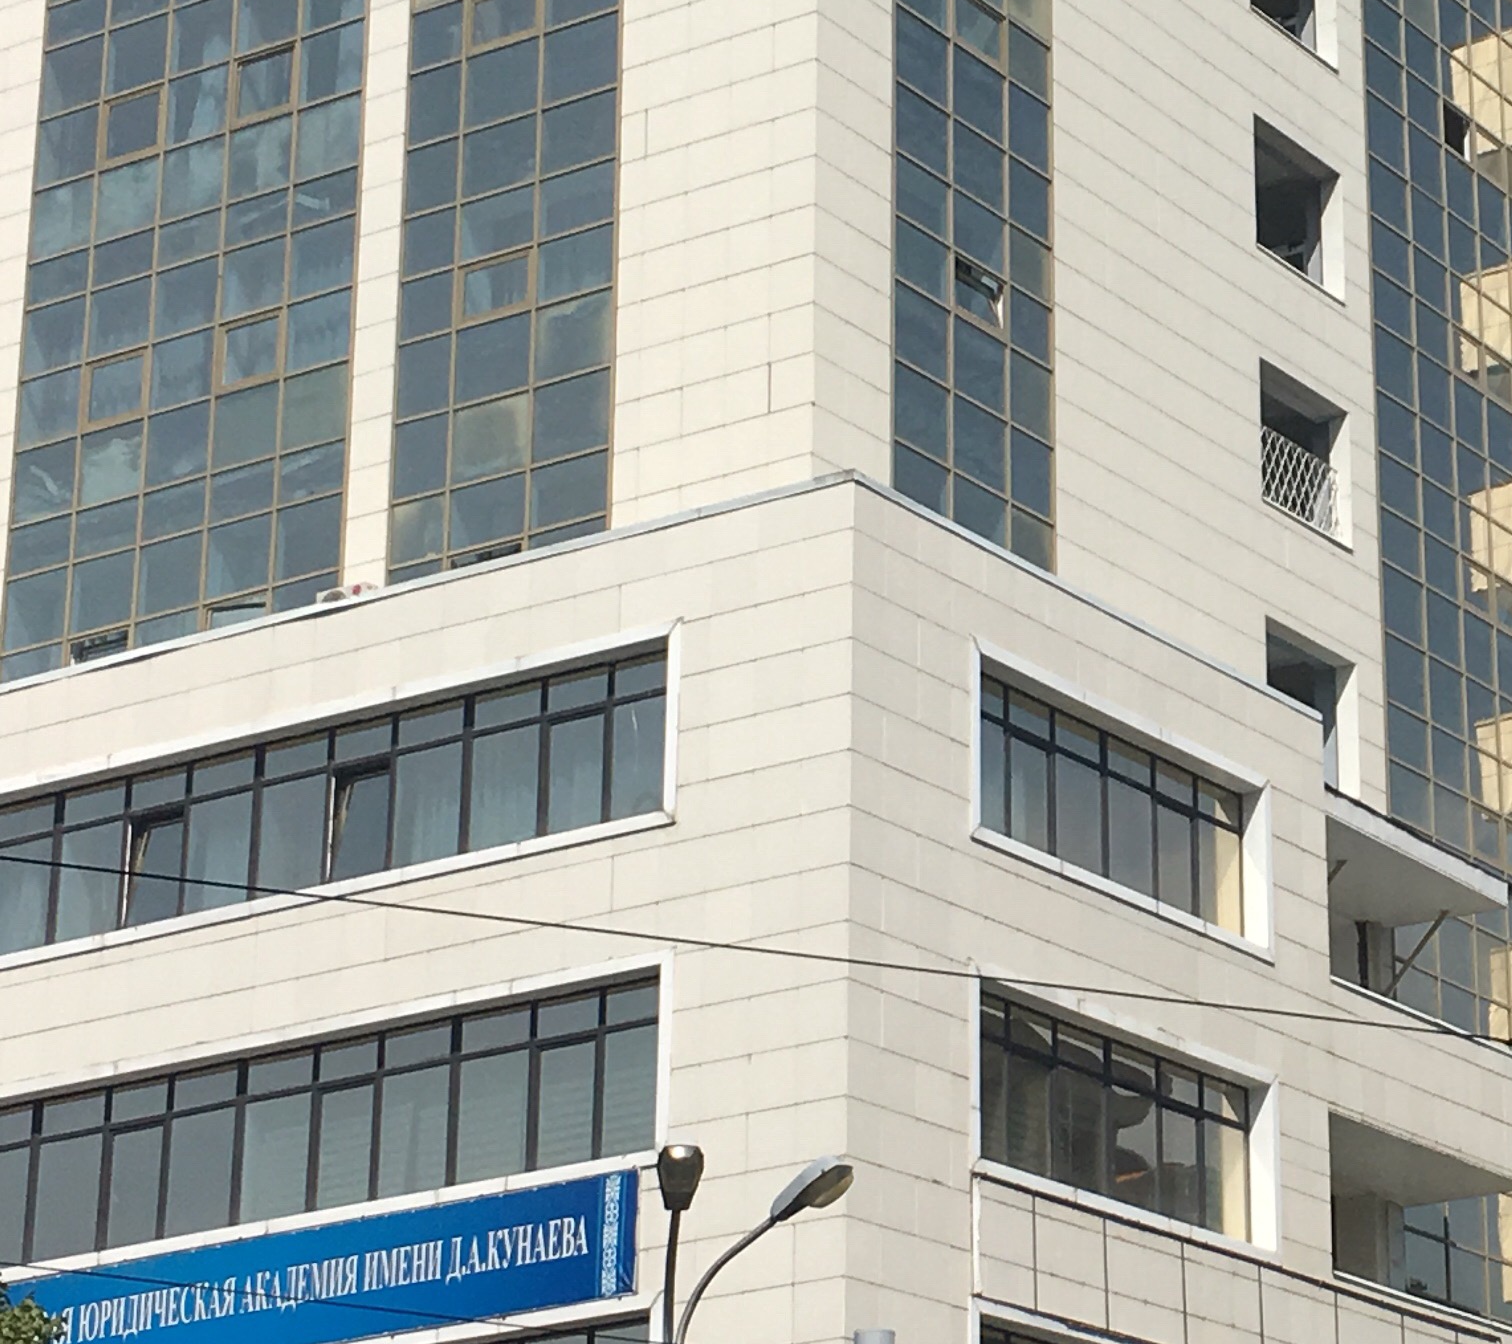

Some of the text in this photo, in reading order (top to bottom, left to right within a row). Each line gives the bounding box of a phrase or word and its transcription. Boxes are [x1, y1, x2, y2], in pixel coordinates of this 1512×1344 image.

[77, 1276, 237, 1344] ЮРИДИЧЕСКАЯ
[239, 1257, 358, 1316] АКАДЕМИЯ
[363, 1242, 442, 1293] ИМЕНИ
[444, 1215, 589, 1286] Д.А.КУНАЕВА
